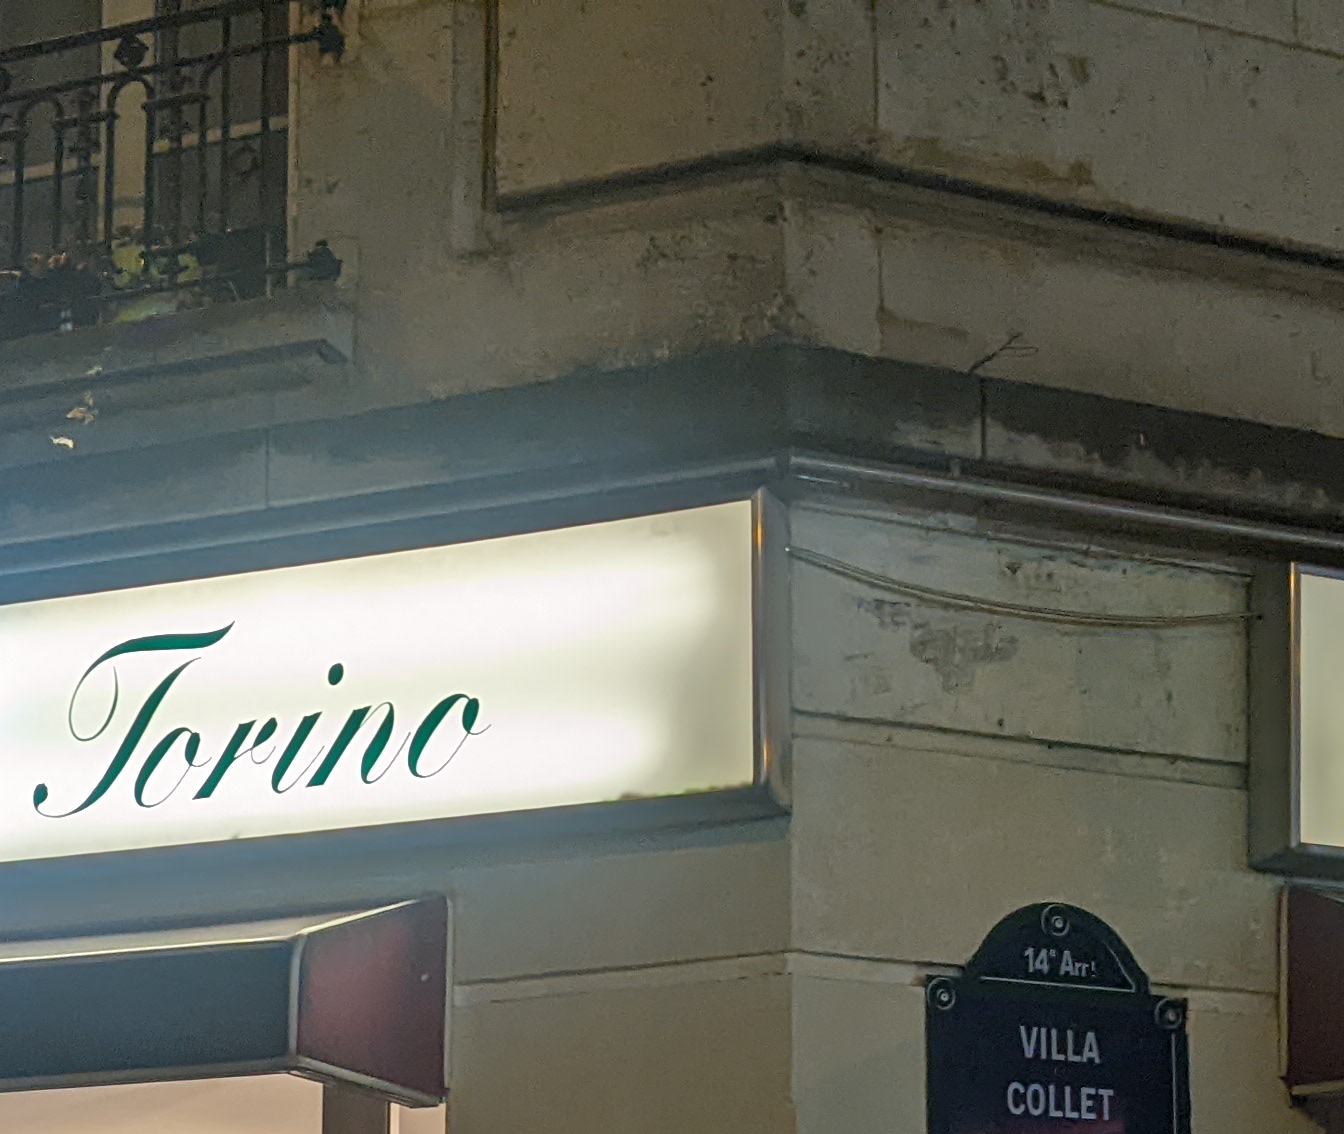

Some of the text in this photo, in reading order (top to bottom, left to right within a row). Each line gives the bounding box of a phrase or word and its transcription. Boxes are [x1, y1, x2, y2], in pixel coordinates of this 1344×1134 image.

[33, 620, 491, 817] Torino
[1019, 1025, 1102, 1065] VILLA
[1006, 1081, 1114, 1121] COLLET
